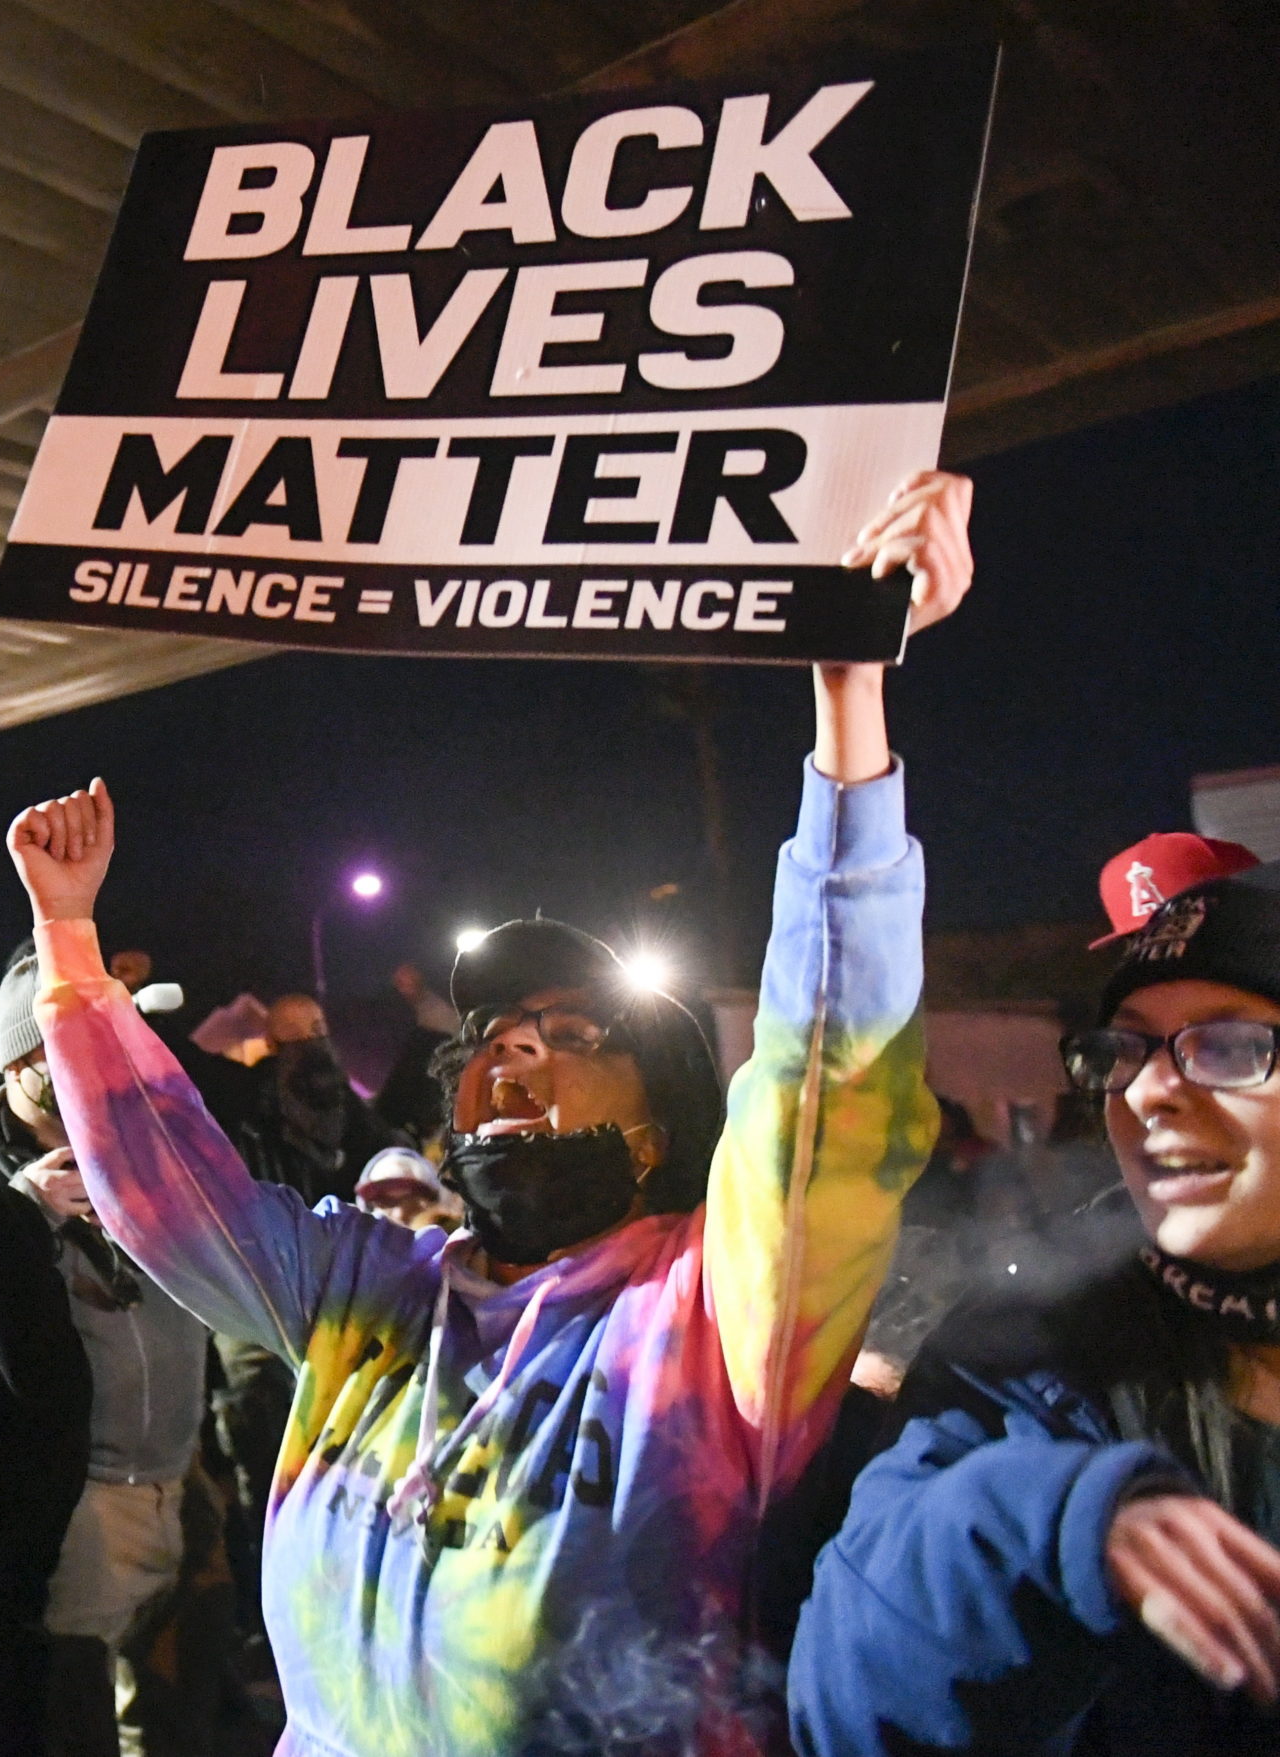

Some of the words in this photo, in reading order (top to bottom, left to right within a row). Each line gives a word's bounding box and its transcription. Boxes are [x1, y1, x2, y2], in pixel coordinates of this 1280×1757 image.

[183, 80, 875, 262] BLACK
[175, 249, 795, 400] LIVES
[92, 428, 810, 545] MATTER
[69, 559, 344, 623] SILENCE
[358, 592, 392, 616] =
[414, 578, 794, 633] VIOLENCE
[1125, 861, 1165, 917] A
